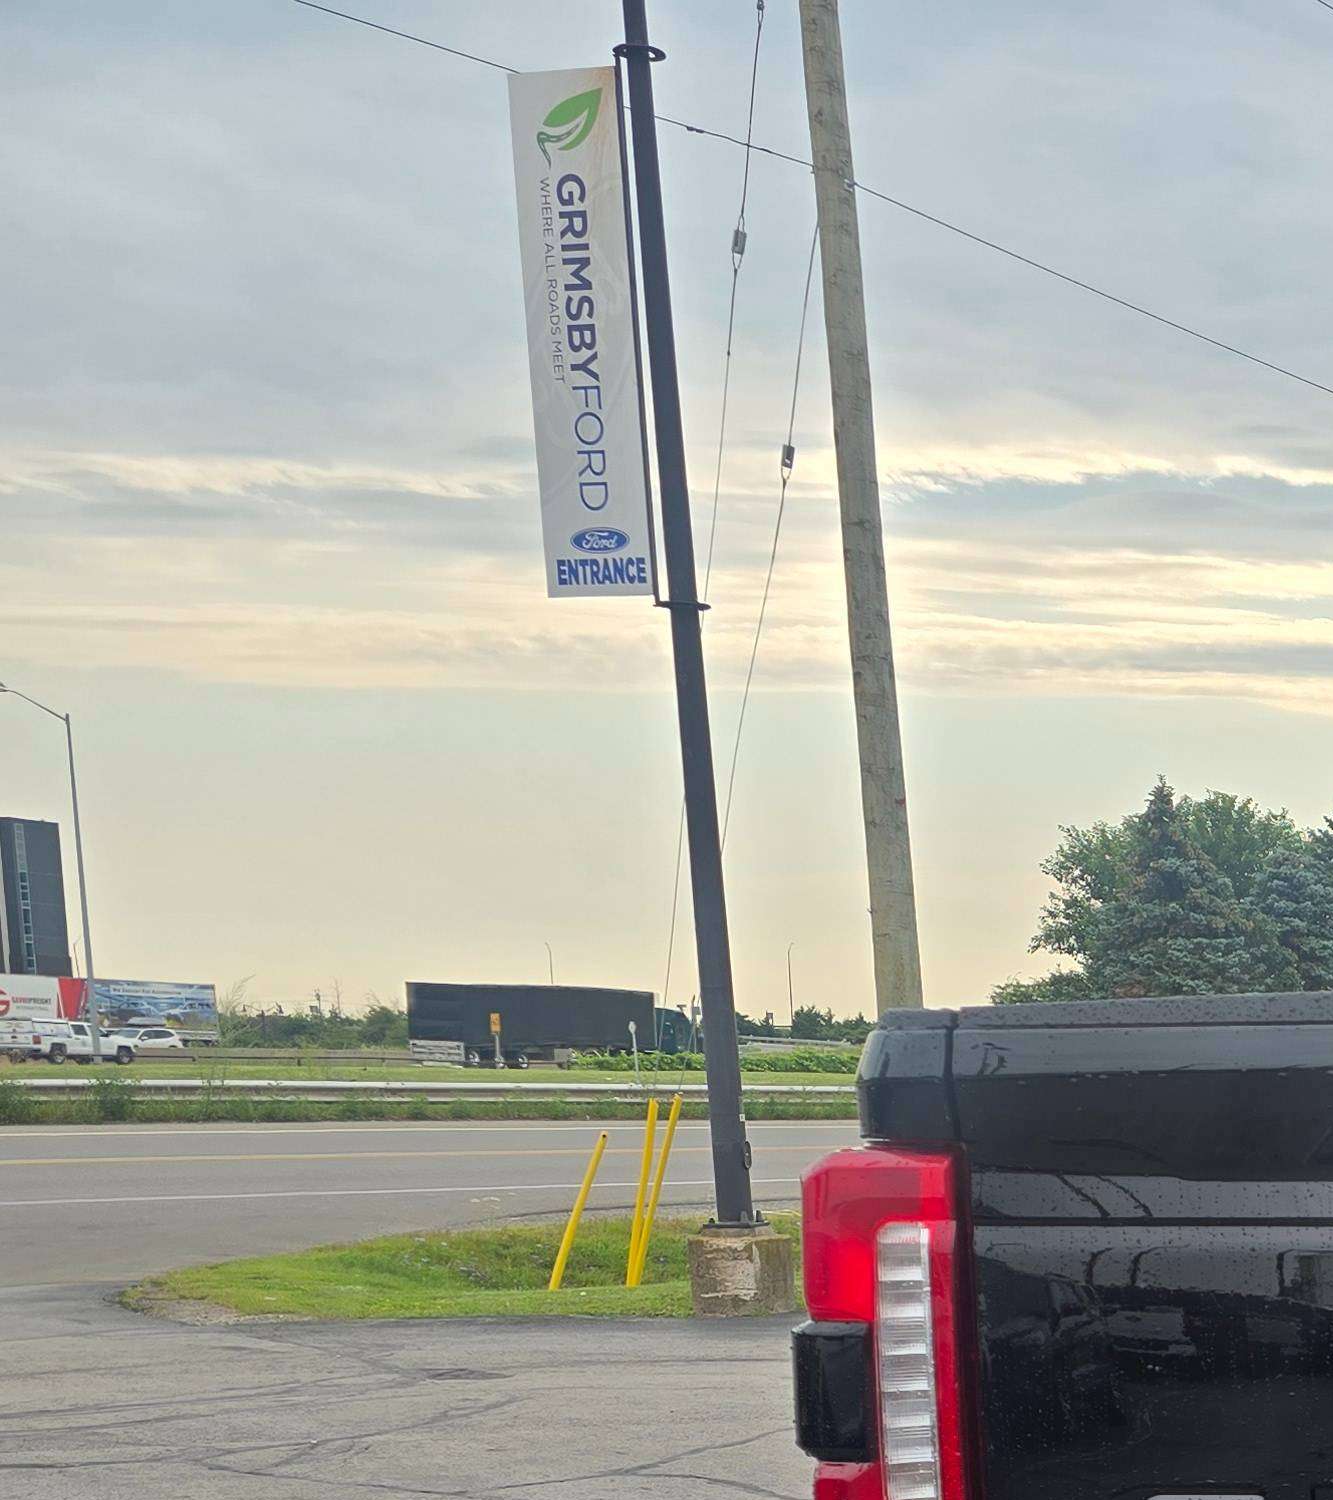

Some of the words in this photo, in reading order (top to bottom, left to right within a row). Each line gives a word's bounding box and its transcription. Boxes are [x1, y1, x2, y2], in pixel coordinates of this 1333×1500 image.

[539, 176, 554, 240] WHERE
[544, 242, 556, 273] ALL
[546, 277, 562, 336] ROADS
[551, 340, 566, 384] MEET
[555, 172, 611, 512] GRIMSBYFORD
[581, 531, 619, 549] Ford
[556, 557, 648, 586] ENTRANCE
